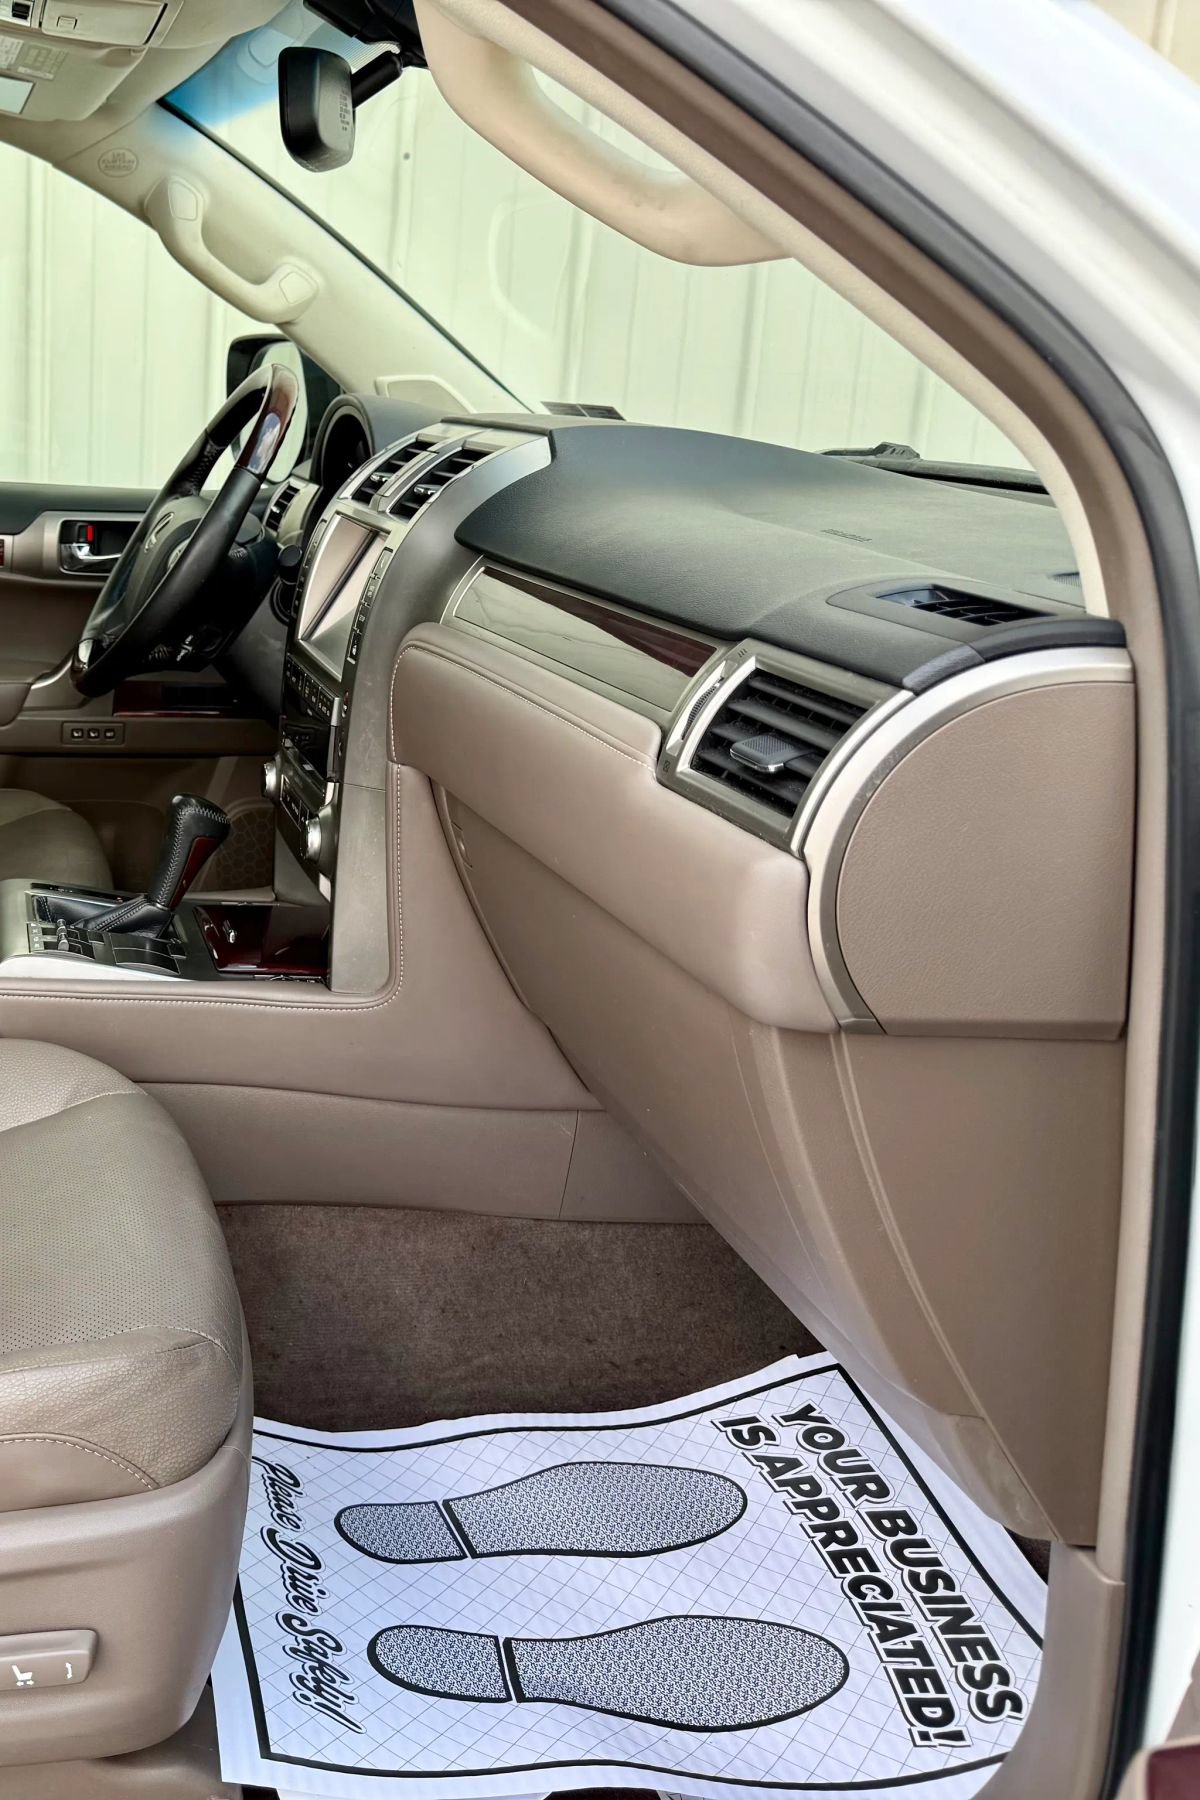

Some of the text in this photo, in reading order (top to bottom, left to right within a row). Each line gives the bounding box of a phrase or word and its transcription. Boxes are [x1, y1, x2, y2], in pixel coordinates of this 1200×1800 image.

[251, 1456, 367, 1734] Please Drive Safely!
[711, 1413, 973, 1748] IS APPRECIATED!
[772, 1400, 1026, 1724] YOUR BUSINESS
